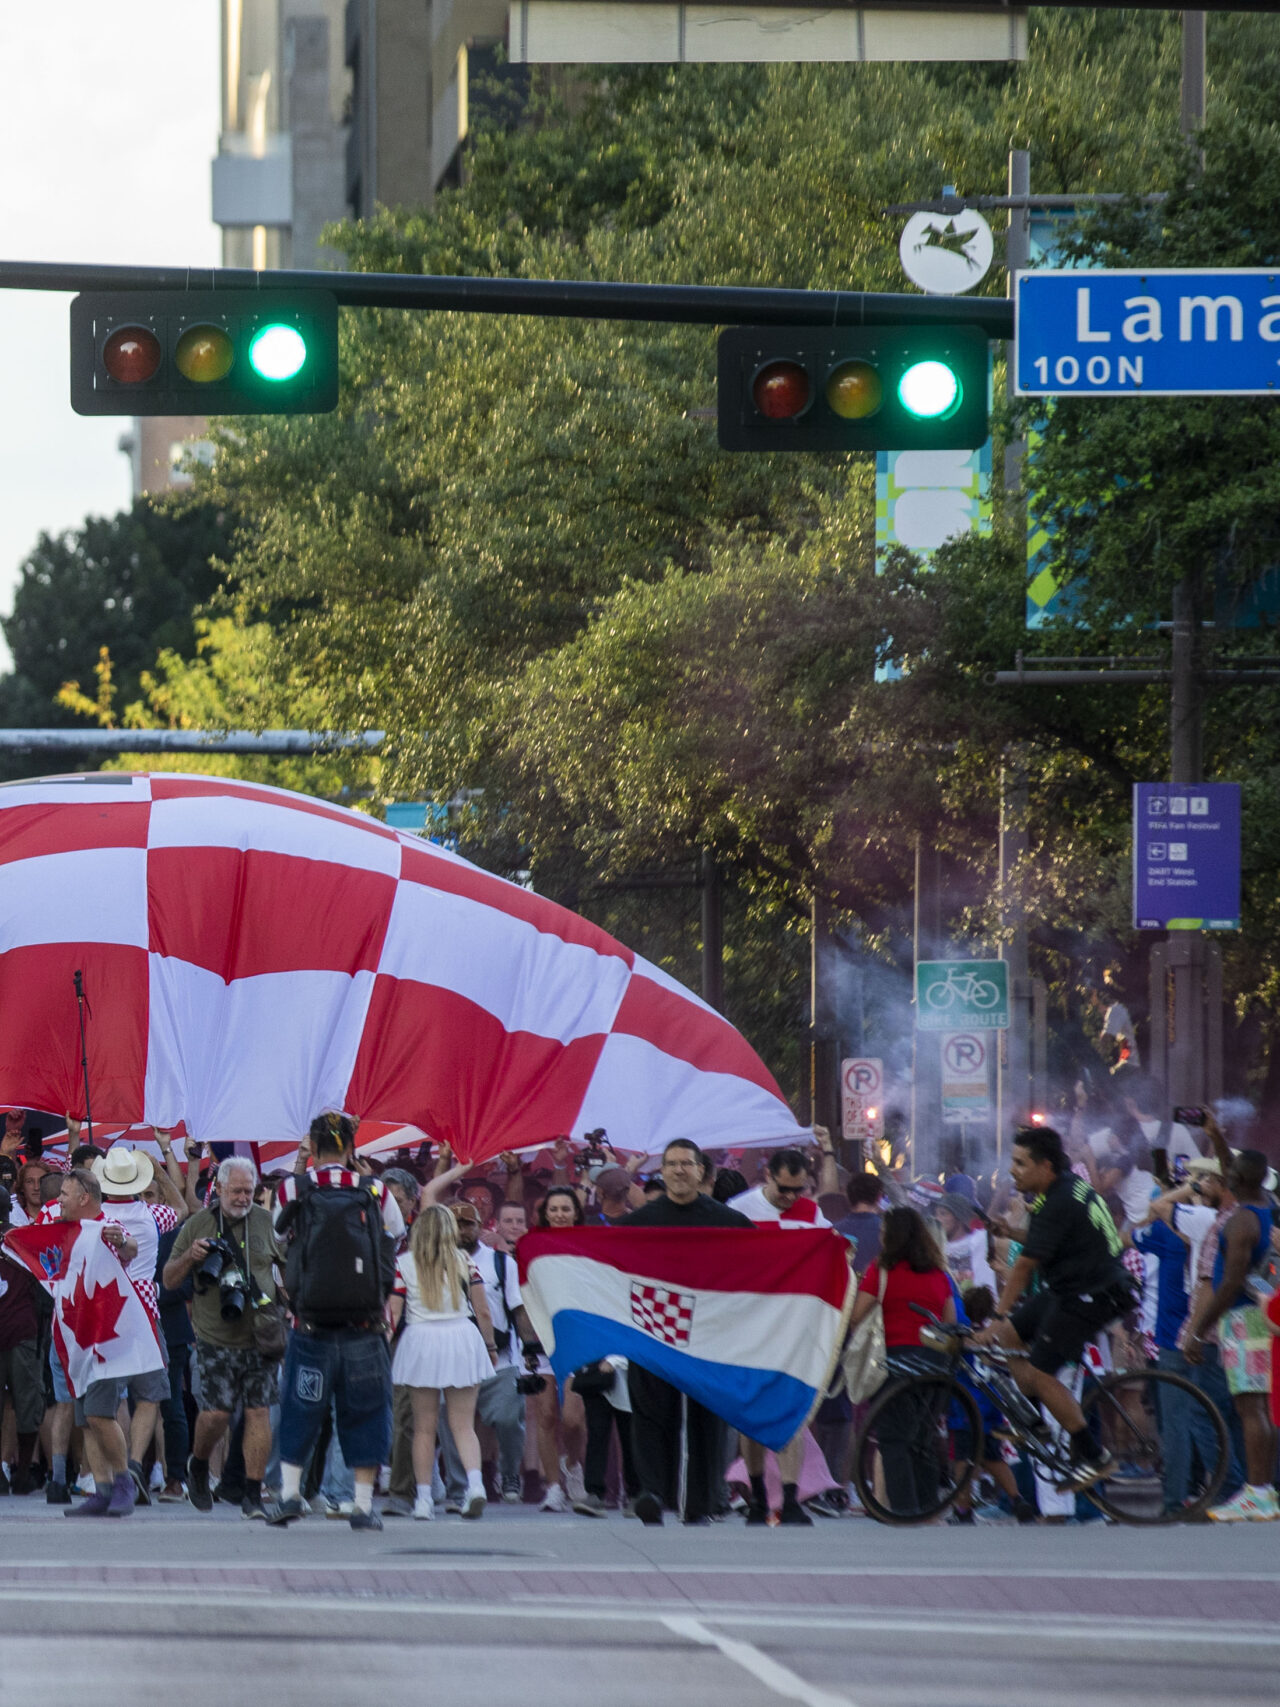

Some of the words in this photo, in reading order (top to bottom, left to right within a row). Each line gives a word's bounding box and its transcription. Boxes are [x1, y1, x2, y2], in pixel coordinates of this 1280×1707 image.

[1033, 355, 1143, 385] 100N
[920, 1014, 952, 1026] BIKE
[960, 1013, 1007, 1025] ROUTE
